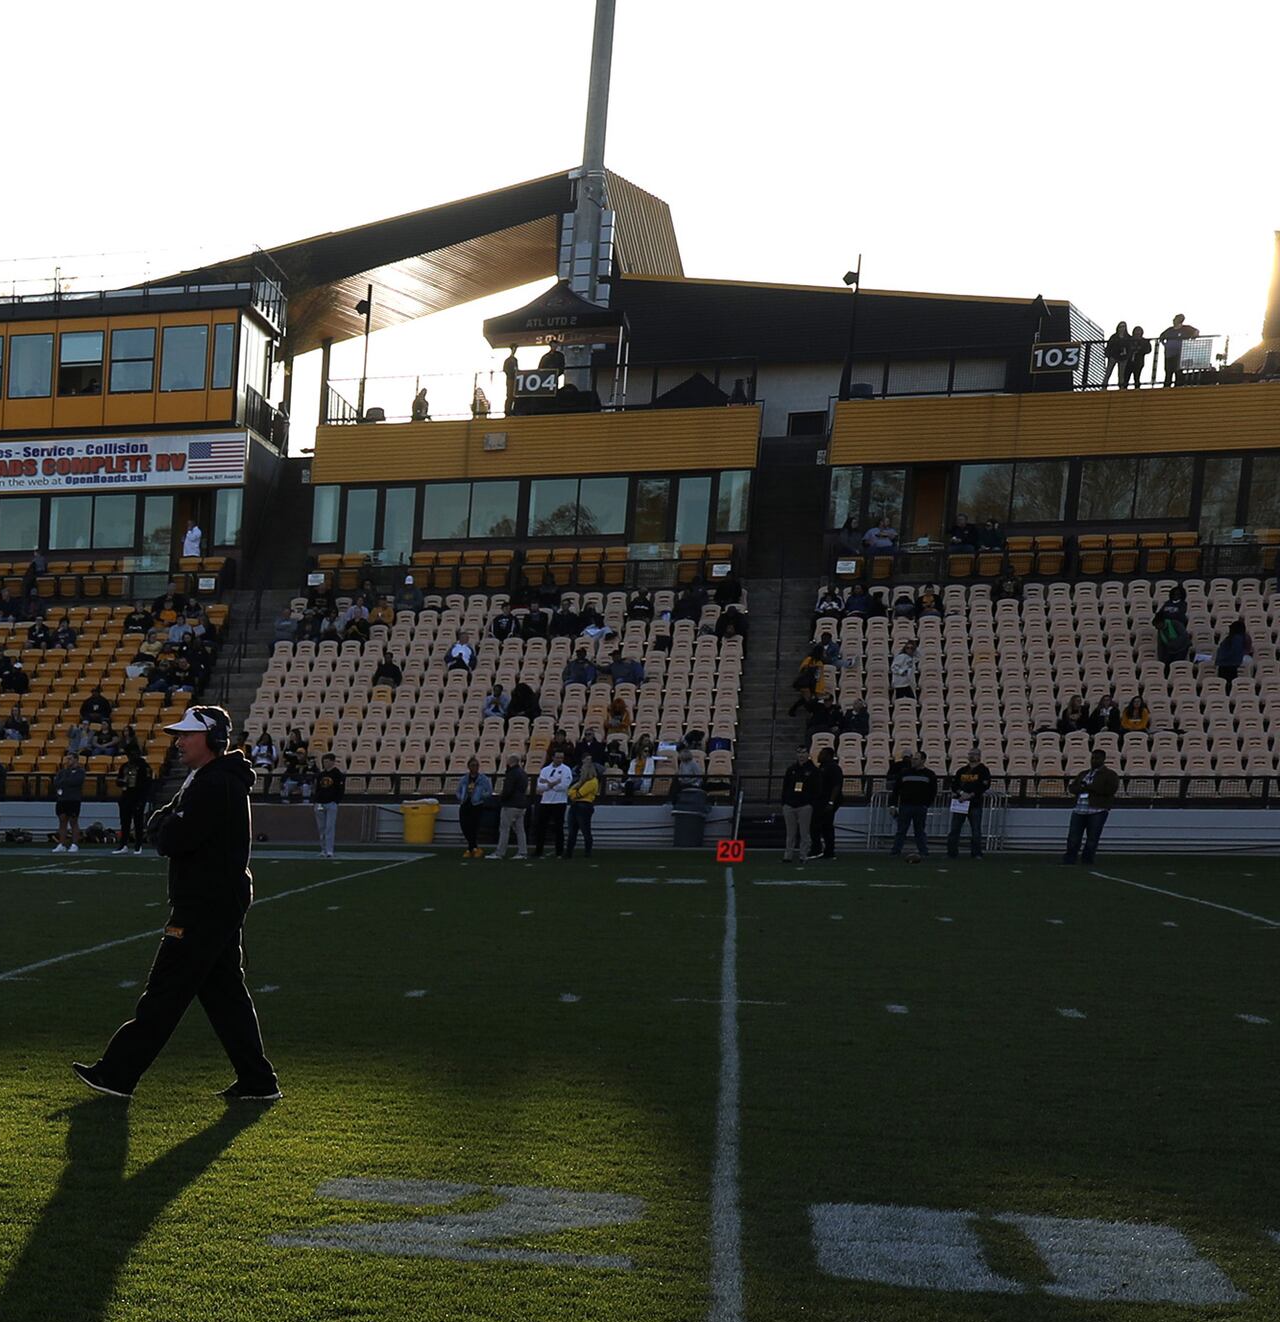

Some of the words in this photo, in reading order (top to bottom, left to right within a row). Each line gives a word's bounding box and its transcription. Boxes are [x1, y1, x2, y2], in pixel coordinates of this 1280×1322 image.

[1034, 348, 1080, 367] 103
[516, 374, 557, 391] 104
[23, 445, 74, 457] Service
[86, 443, 148, 455] Collision
[42, 453, 152, 476] COMPLETE
[155, 453, 187, 472] RV
[8, 478, 25, 487] the
[28, 477, 49, 486] web
[65, 473, 147, 485] OpenRoads.us!
[720, 842, 741, 858] 20
